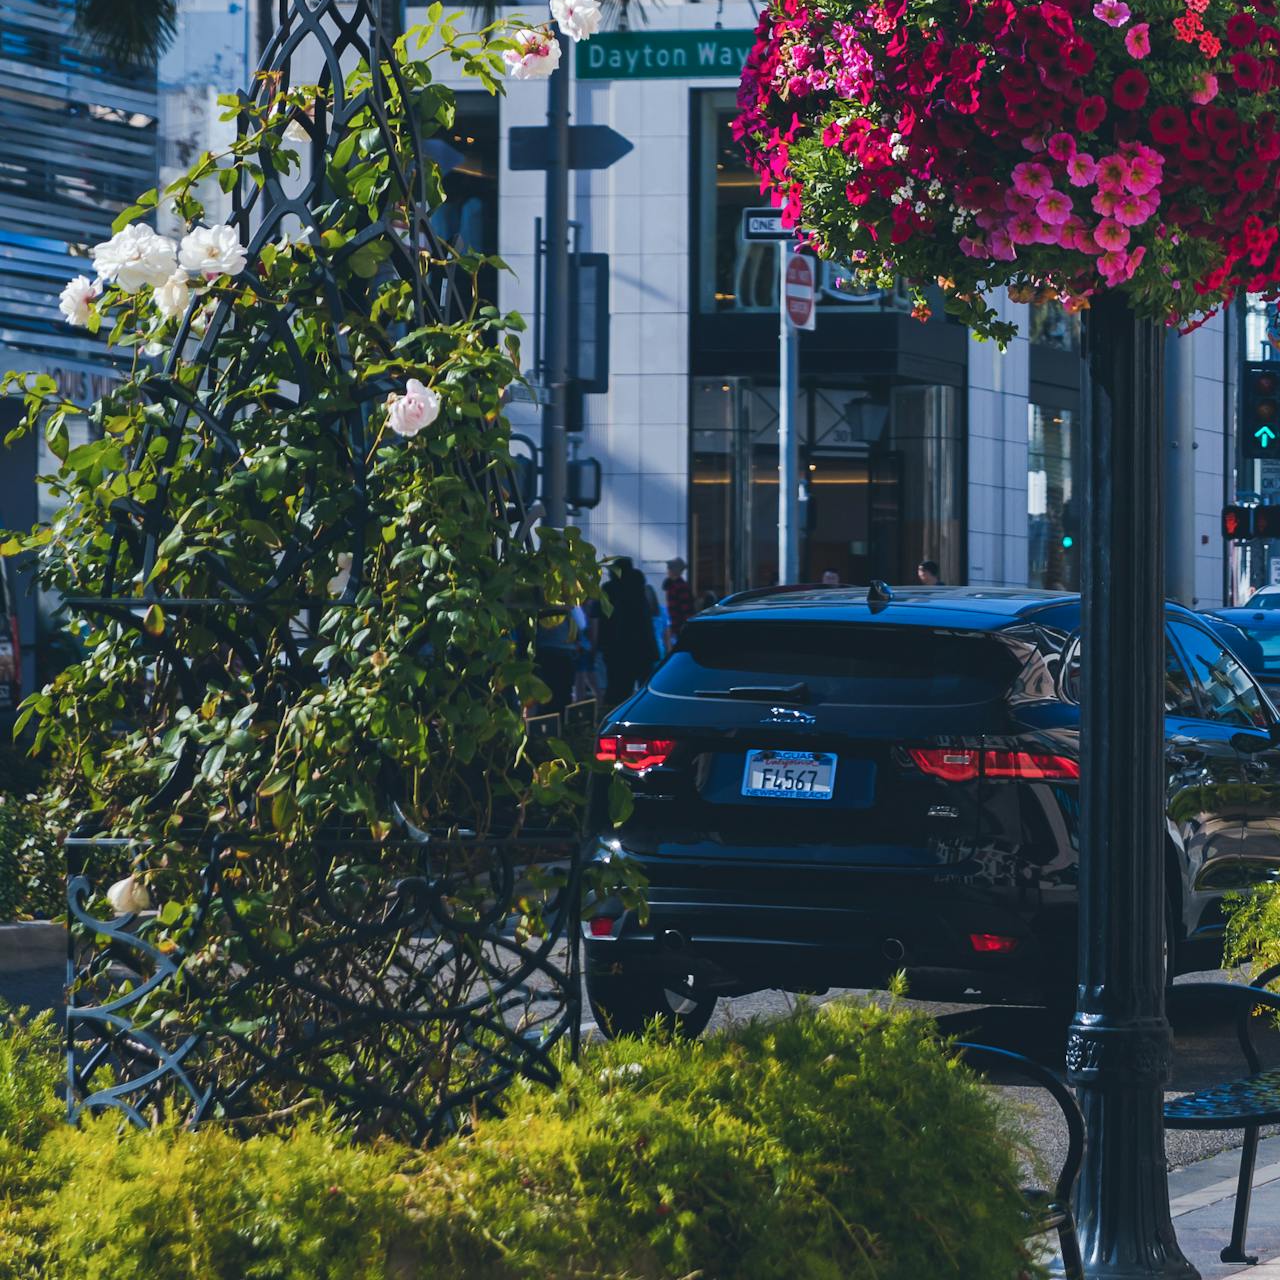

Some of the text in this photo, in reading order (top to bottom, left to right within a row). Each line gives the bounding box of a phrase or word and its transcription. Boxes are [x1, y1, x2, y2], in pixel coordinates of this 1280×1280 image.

[589, 41, 750, 72] Dayton Way
[751, 219, 776, 231] ONE
[761, 768, 818, 791] F4567
[746, 789, 829, 799] NEWPORT BEACH
